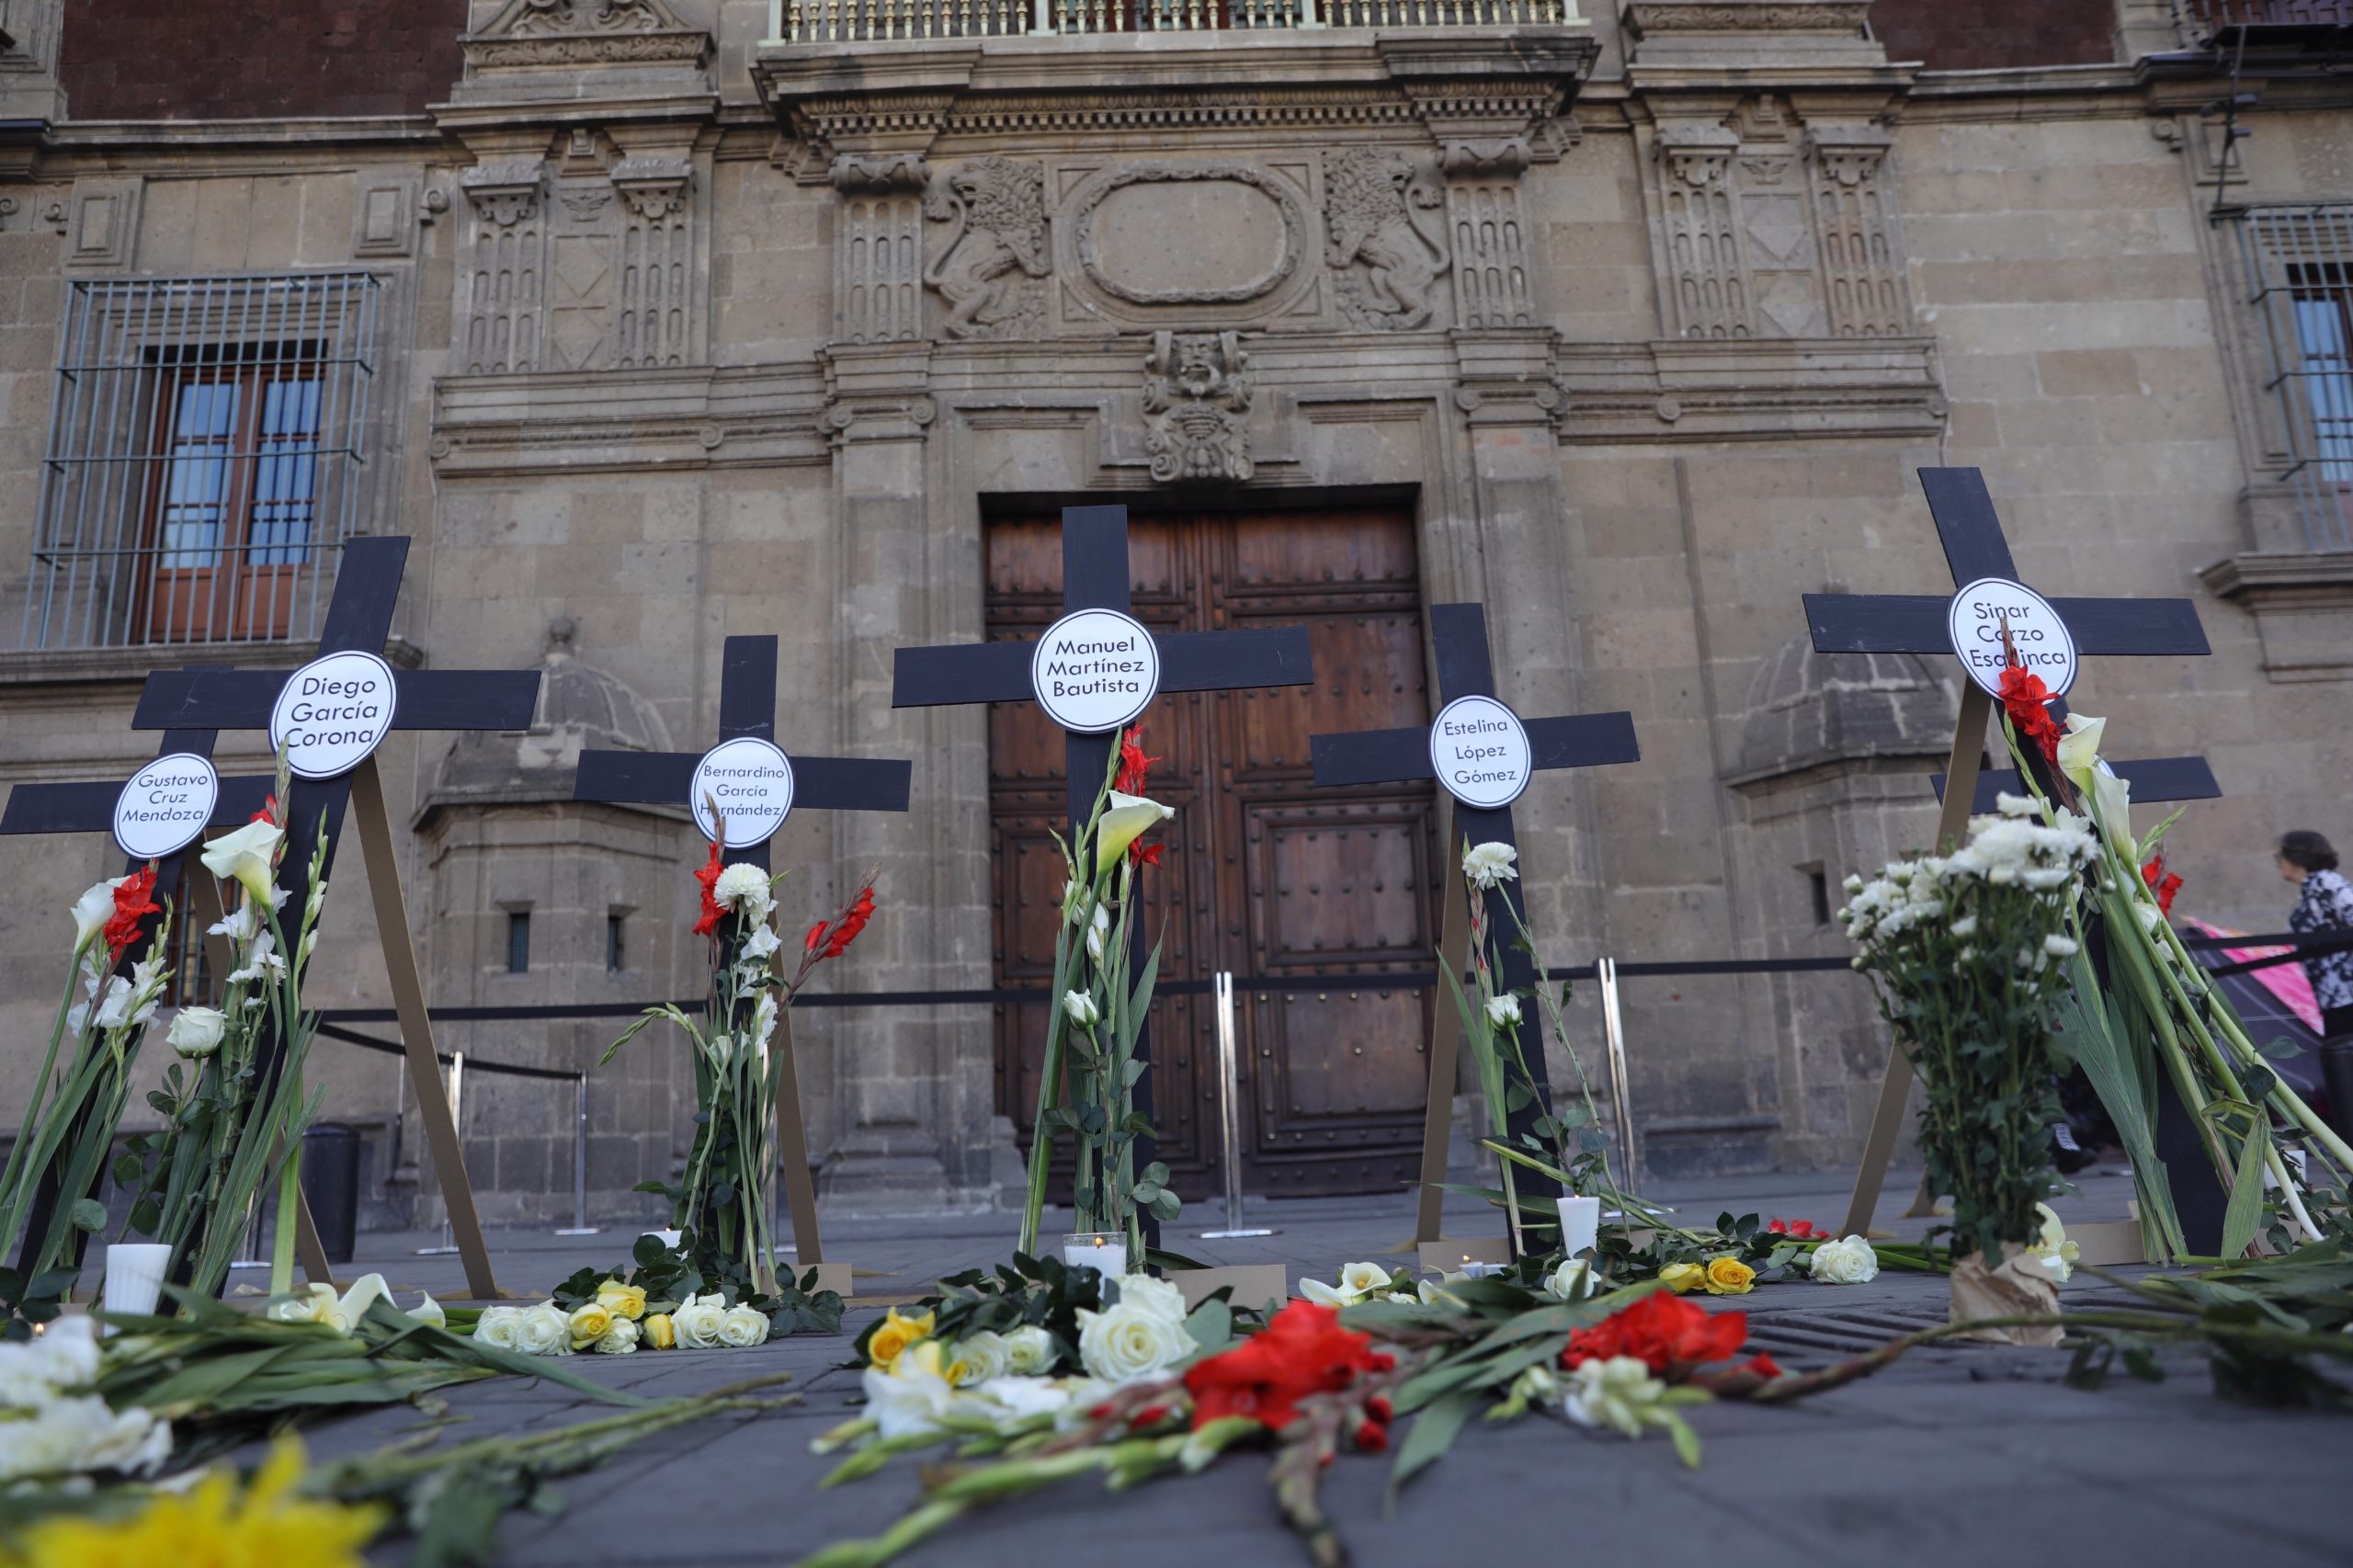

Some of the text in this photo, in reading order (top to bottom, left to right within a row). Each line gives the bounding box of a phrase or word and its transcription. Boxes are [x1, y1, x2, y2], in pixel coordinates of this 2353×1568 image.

[1973, 602, 2029, 619] Sinar
[1055, 636, 1134, 655] Manuel
[1047, 658, 1144, 676] Martínez
[1970, 649, 2066, 670] Esqinca
[302, 677, 376, 699] Diego
[1053, 678, 1139, 697] Bautista
[291, 701, 378, 722] García
[1444, 720, 1507, 735] Estelina
[285, 728, 373, 748] Corona
[1455, 745, 1506, 762] López
[703, 766, 784, 778] Bernardino
[1454, 769, 1517, 784] Gómez
[138, 774, 208, 788] Gustavo
[149, 790, 188, 804] Cruz
[717, 784, 767, 797] García
[121, 807, 204, 823] Mendoza
[700, 803, 780, 816] Hrnández
